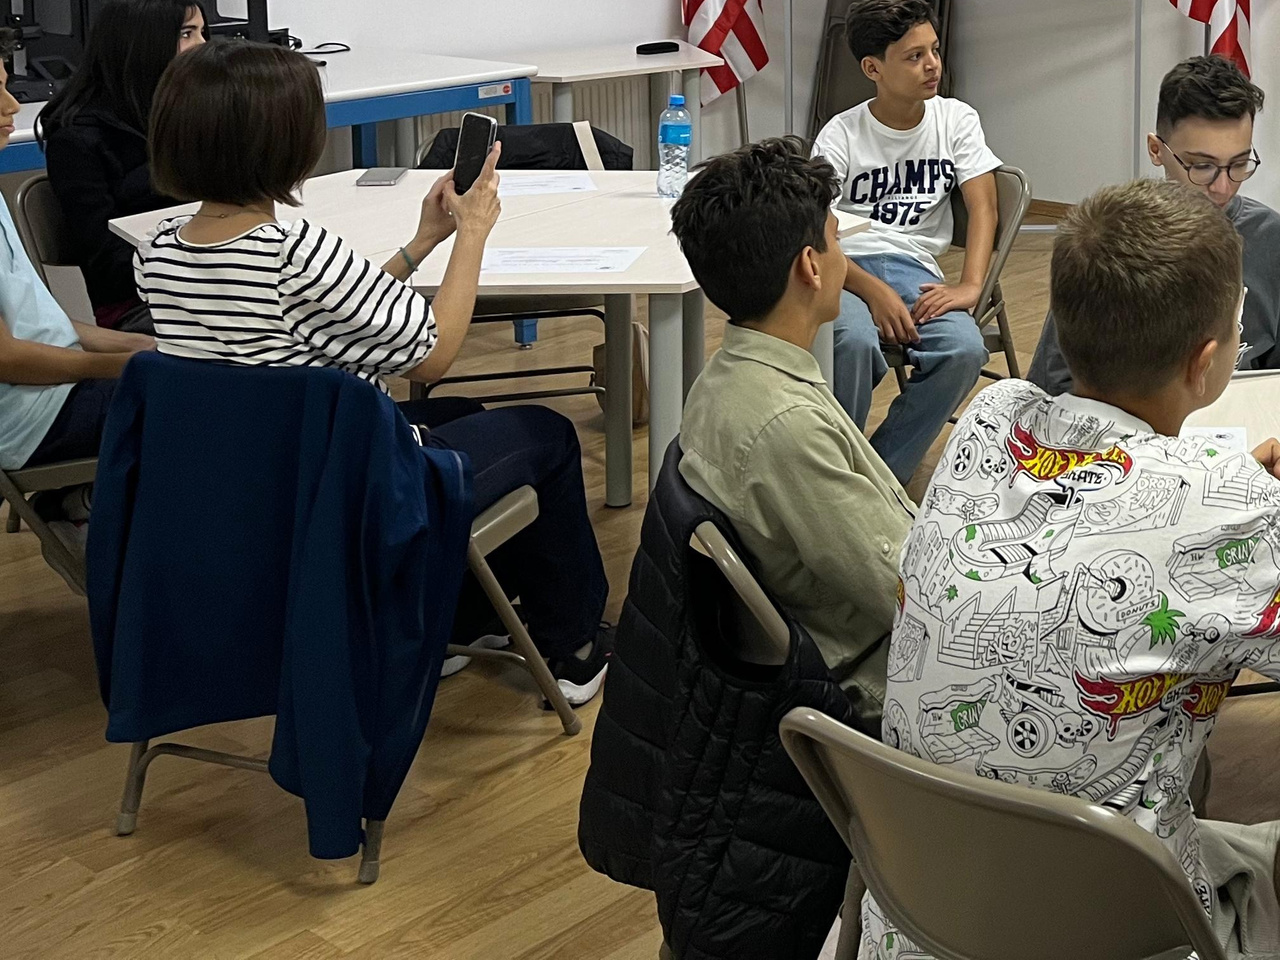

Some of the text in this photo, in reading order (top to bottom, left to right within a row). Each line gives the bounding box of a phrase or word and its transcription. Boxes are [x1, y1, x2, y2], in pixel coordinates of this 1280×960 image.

[850, 158, 955, 205] CHAMPS
[869, 200, 932, 227] 1975
[1120, 600, 1156, 618] DONUTS
[1110, 676, 1163, 714] HOT
